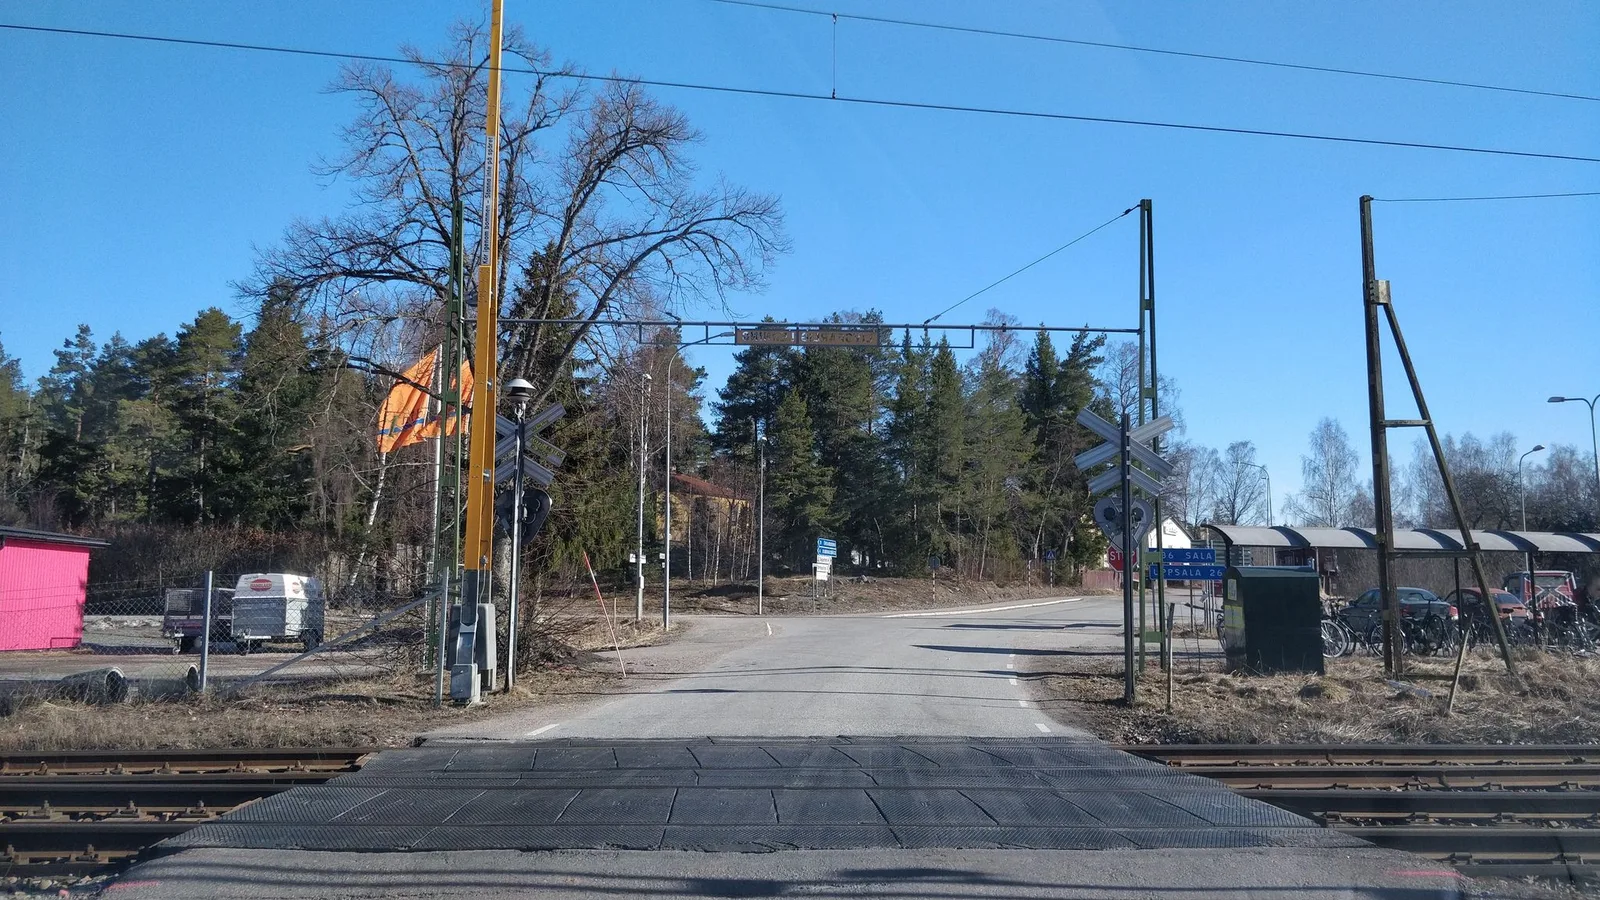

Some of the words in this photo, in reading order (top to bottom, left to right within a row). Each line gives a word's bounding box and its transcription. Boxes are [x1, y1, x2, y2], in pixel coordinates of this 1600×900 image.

[1109, 551, 1136, 560] STP
[1185, 552, 1212, 560] SALA
[1153, 568, 1202, 576] UPPSALA
[1209, 568, 1223, 577] 26
